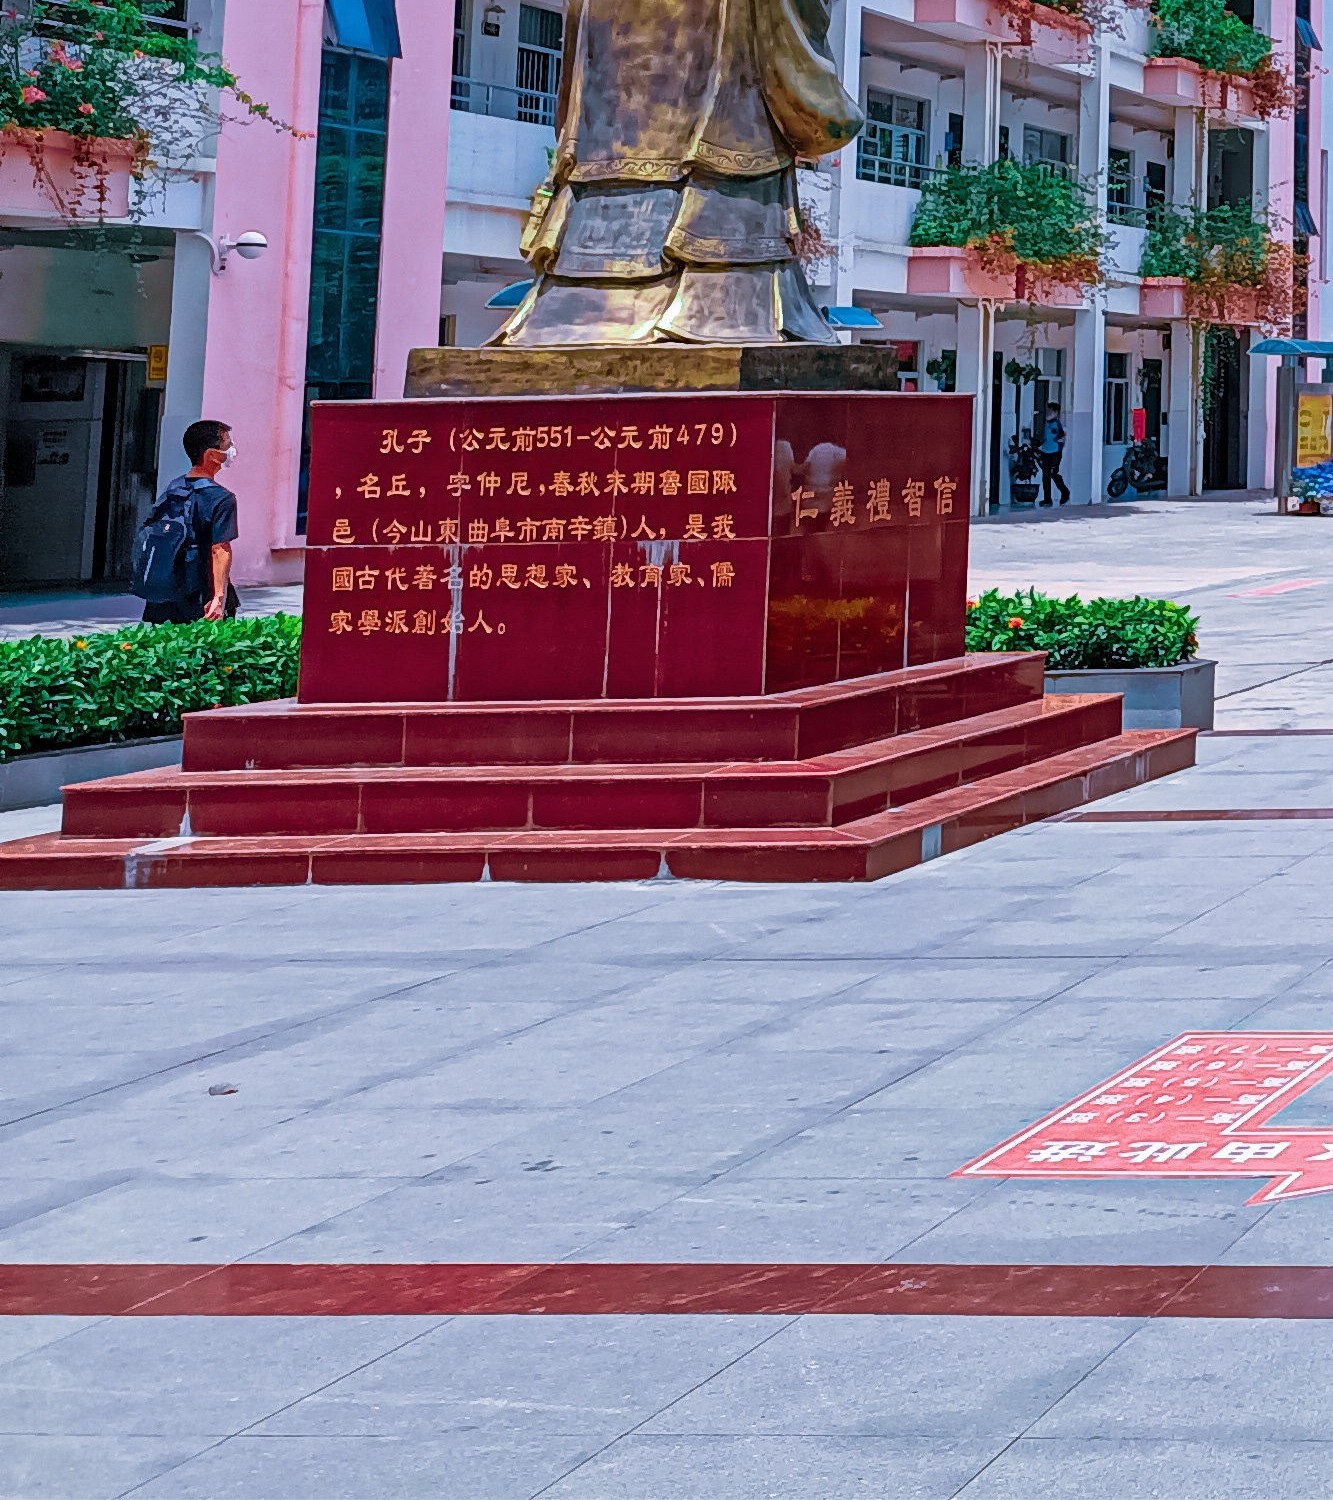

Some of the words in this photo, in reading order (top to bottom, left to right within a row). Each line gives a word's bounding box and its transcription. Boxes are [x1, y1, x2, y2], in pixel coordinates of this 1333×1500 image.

[790, 475, 958, 528] 仁義禮智信
[1025, 1140, 1293, 1164] 由此进
